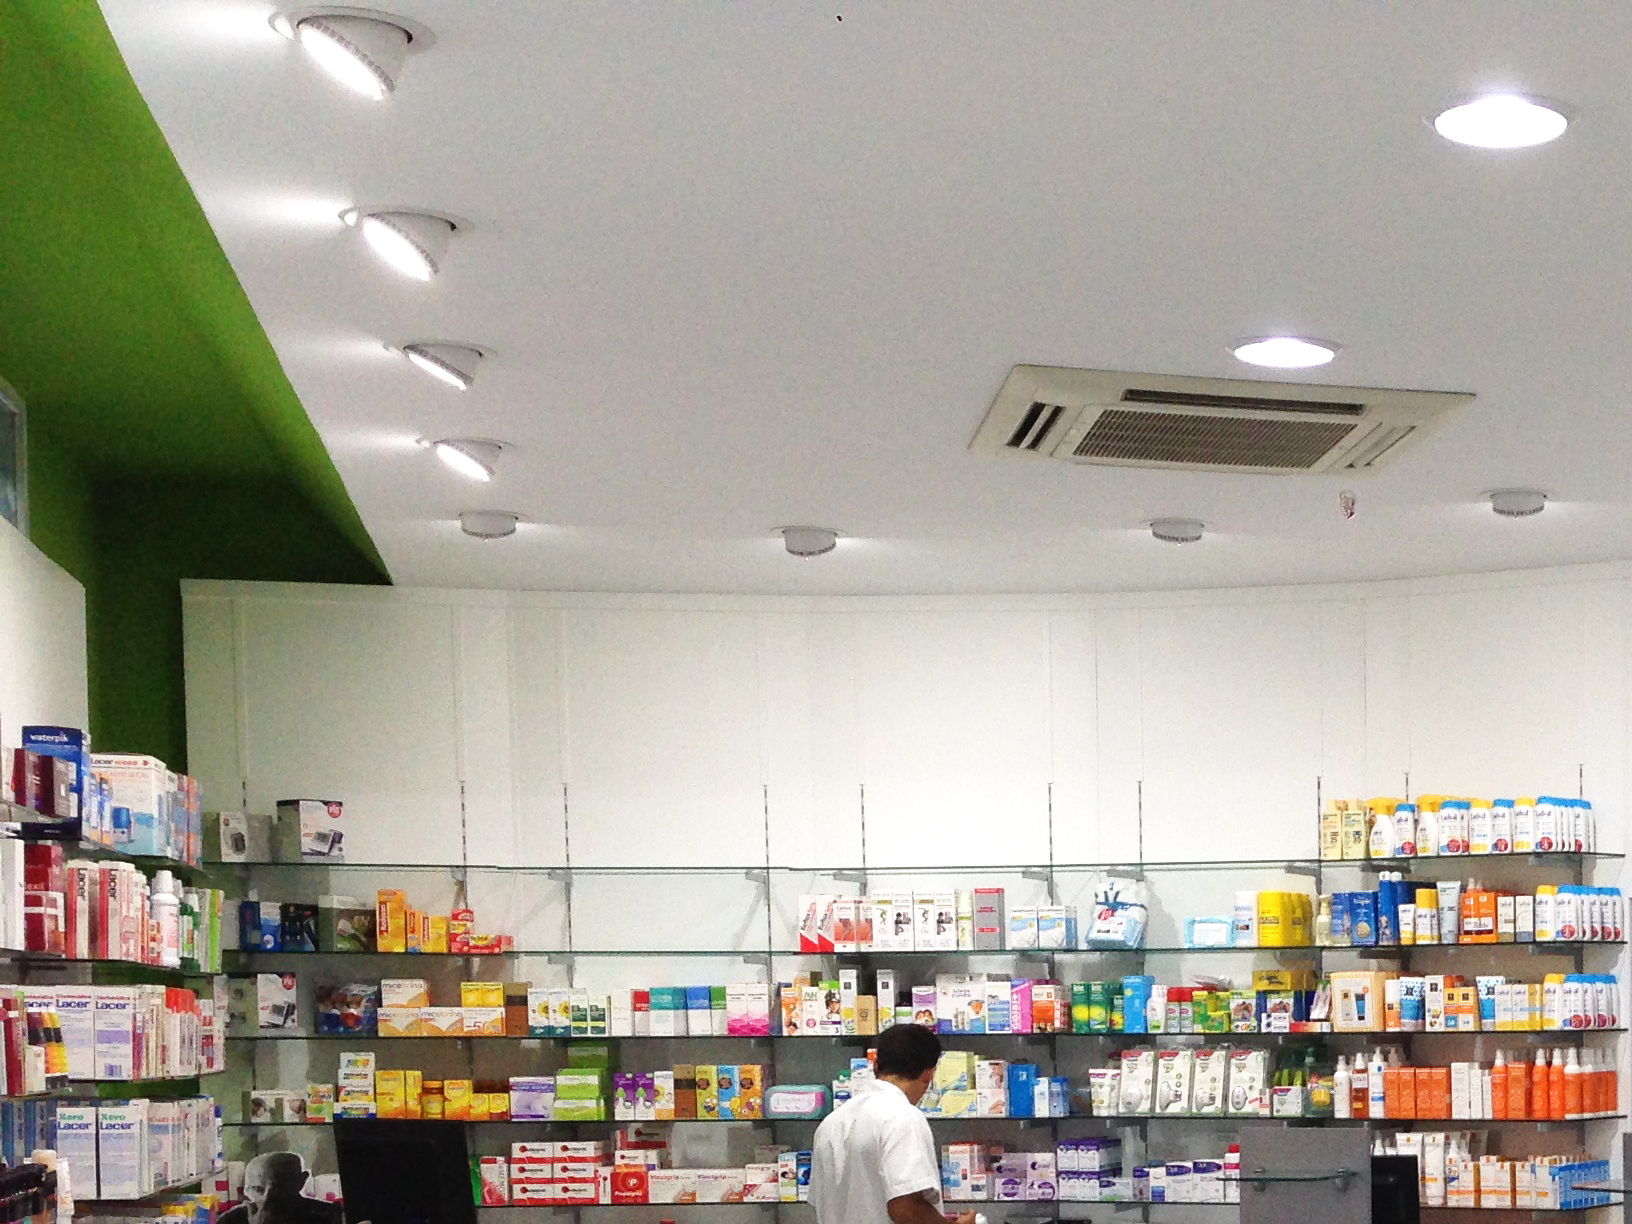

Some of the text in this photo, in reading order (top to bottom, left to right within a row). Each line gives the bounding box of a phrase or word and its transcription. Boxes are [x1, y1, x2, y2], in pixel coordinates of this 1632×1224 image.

[77, 867, 88, 899] Lacer
[108, 868, 118, 900] Lacer
[56, 999, 91, 1009] Lacer
[96, 1002, 130, 1010] Lacer
[57, 1121, 92, 1130] Lacer
[100, 1121, 135, 1130] Lacer
